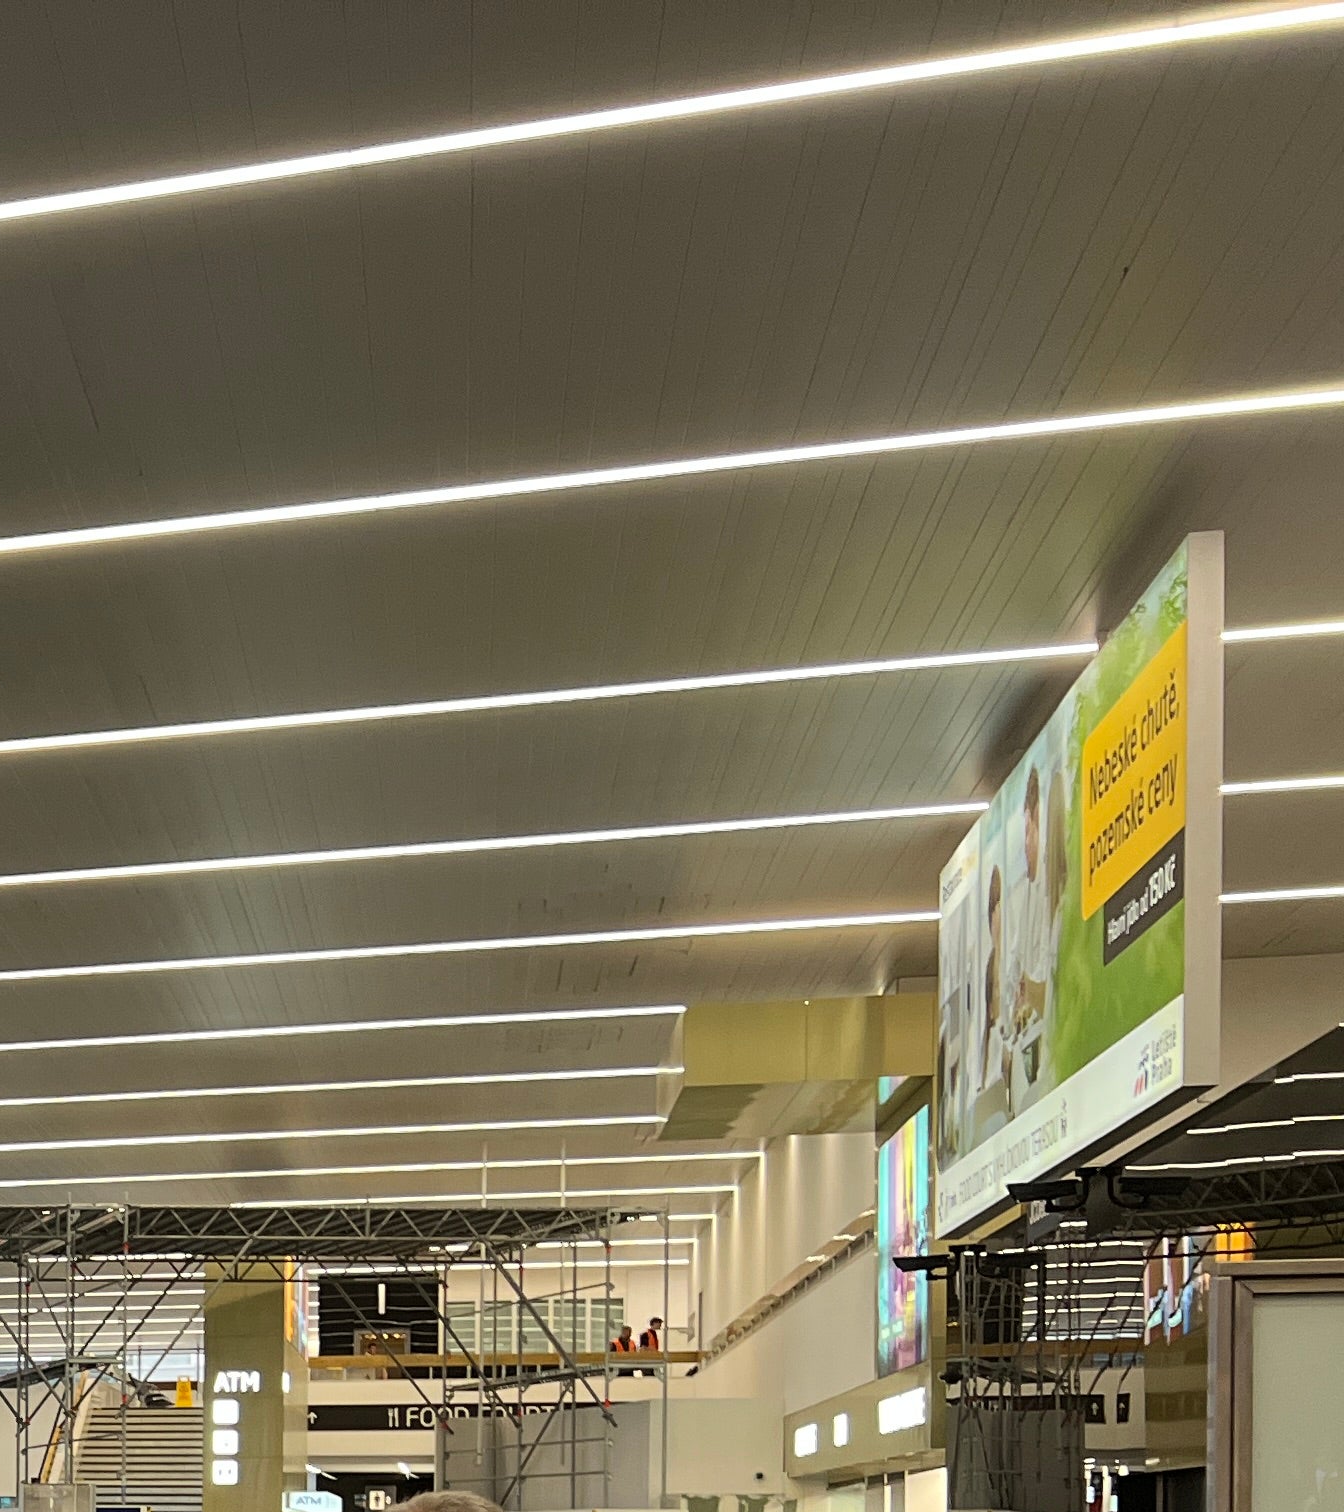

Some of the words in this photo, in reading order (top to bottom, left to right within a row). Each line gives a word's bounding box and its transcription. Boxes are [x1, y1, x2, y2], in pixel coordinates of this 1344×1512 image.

[1089, 713, 1138, 810] Nebeské
[1140, 667, 1180, 752] chutě,
[1089, 777, 1145, 887] pozemské
[1148, 753, 1180, 816] ceny
[214, 1371, 260, 1393] ATM
[296, 1496, 322, 1505] ATM
